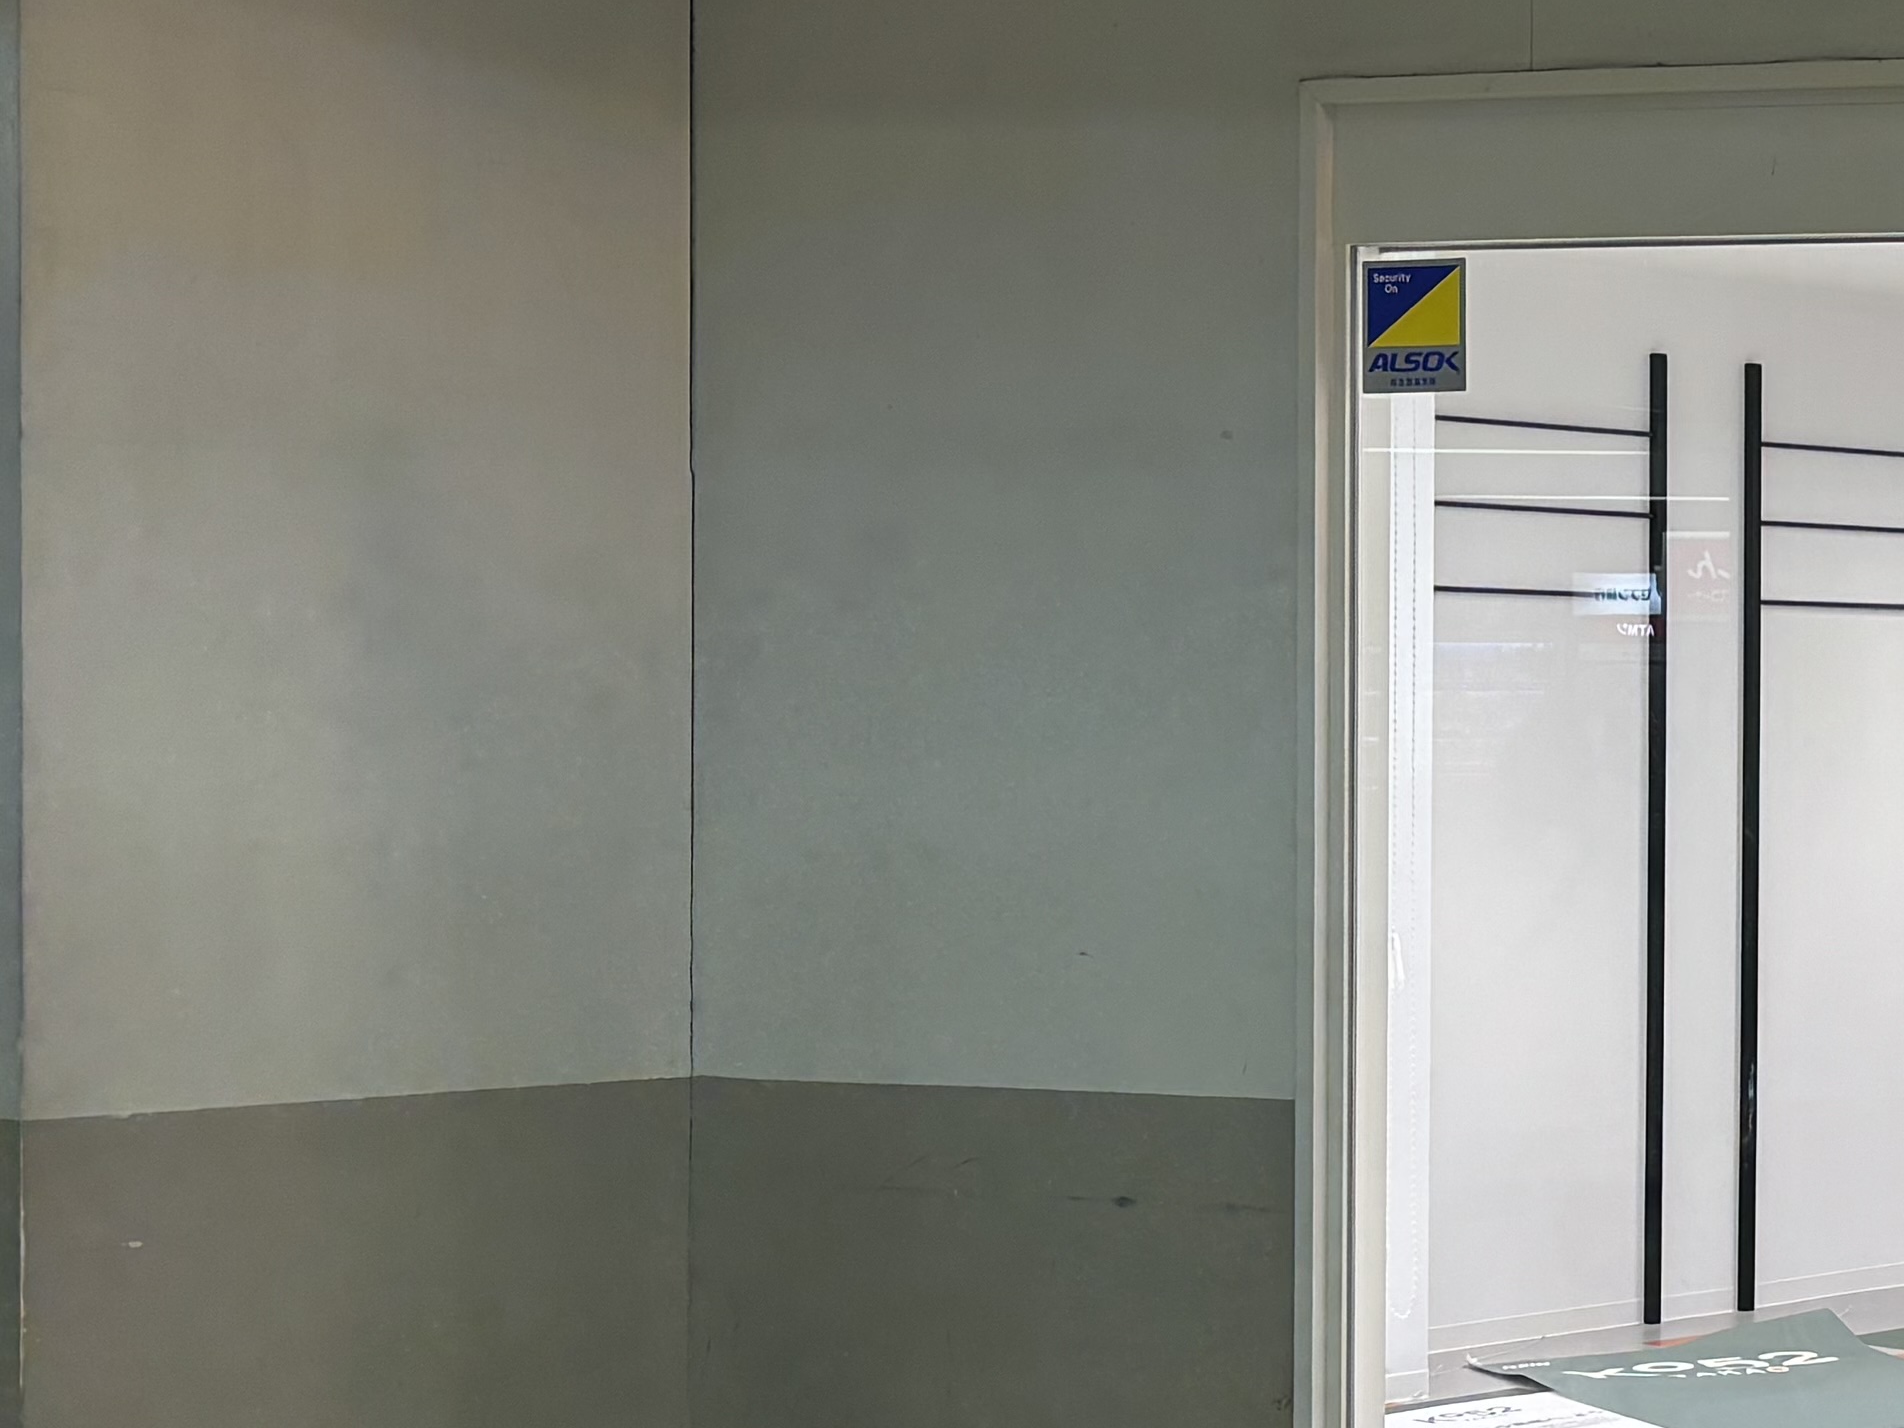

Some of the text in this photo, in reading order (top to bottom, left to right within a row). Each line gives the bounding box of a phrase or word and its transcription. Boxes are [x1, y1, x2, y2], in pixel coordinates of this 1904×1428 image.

[1372, 273, 1411, 283] Security
[1384, 283, 1399, 293] On
[1368, 351, 1460, 375] ALSOK
[1562, 1351, 1839, 1379] KO52
